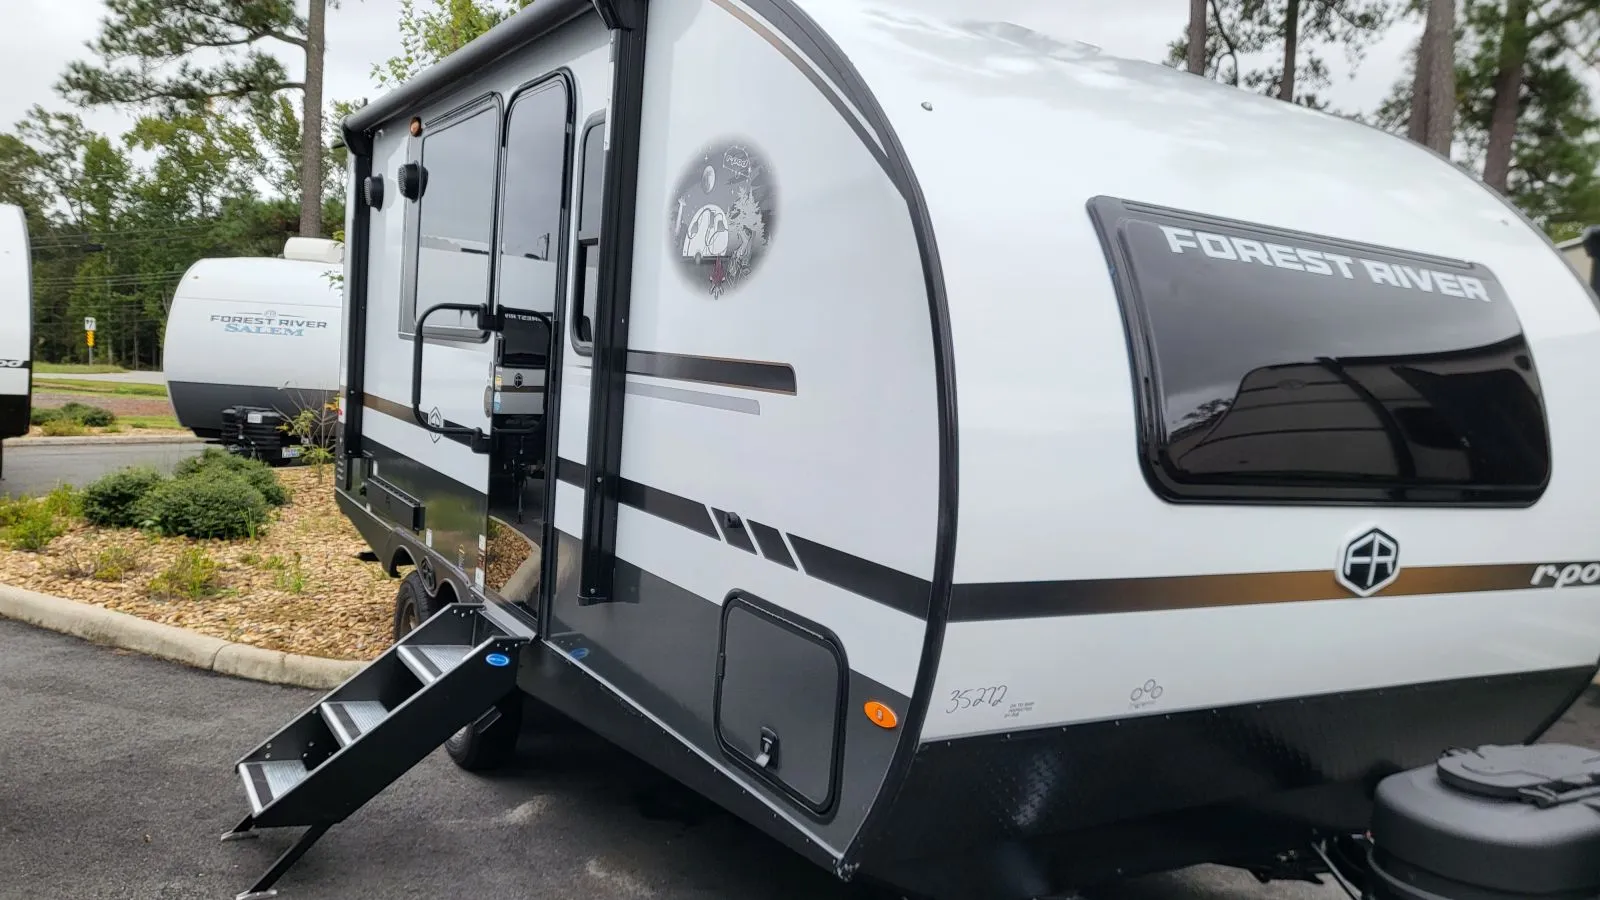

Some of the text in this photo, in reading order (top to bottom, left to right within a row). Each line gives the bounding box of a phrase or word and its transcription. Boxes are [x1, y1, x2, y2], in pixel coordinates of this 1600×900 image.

[1159, 224, 1493, 303] FOREST RIVER
[210, 314, 328, 329] FOREST RIVER
[224, 323, 305, 337] SALEM
[946, 685, 1008, 714] 35272
